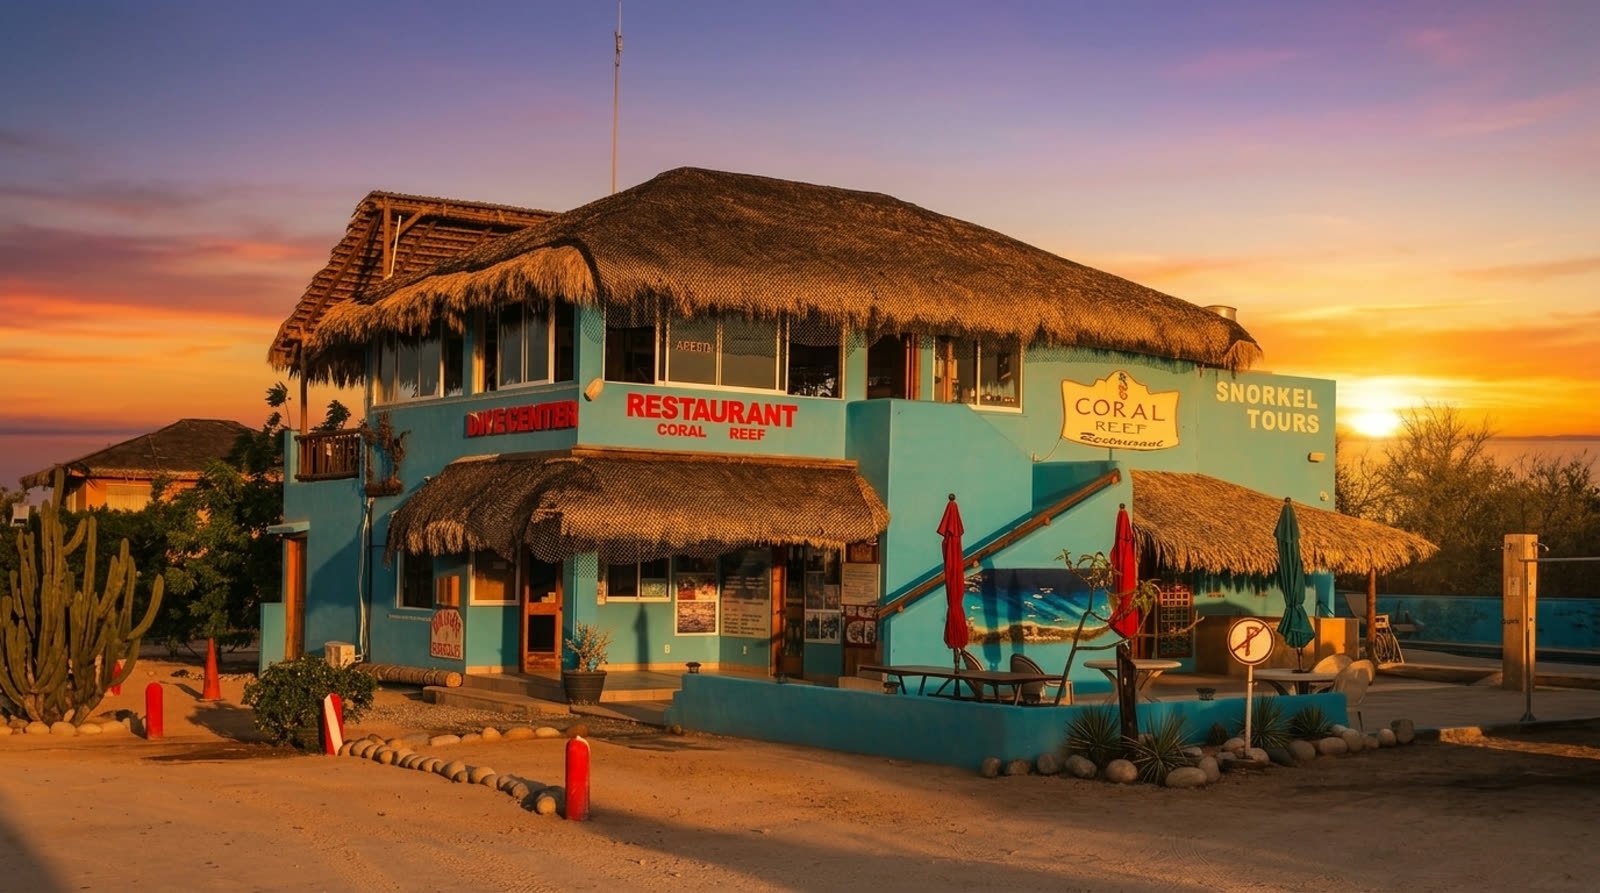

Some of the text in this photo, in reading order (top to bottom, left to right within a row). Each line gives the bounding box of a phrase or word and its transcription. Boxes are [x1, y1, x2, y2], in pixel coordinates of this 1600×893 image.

[1216, 381, 1318, 409] SNORKEL
[466, 399, 578, 437] DIVE CENTER
[627, 393, 798, 428] RESTAURANT
[1075, 397, 1165, 421] CORAL
[1247, 408, 1319, 434] TOURS
[657, 423, 765, 440] CORAL REEF
[1095, 420, 1147, 434] REEF
